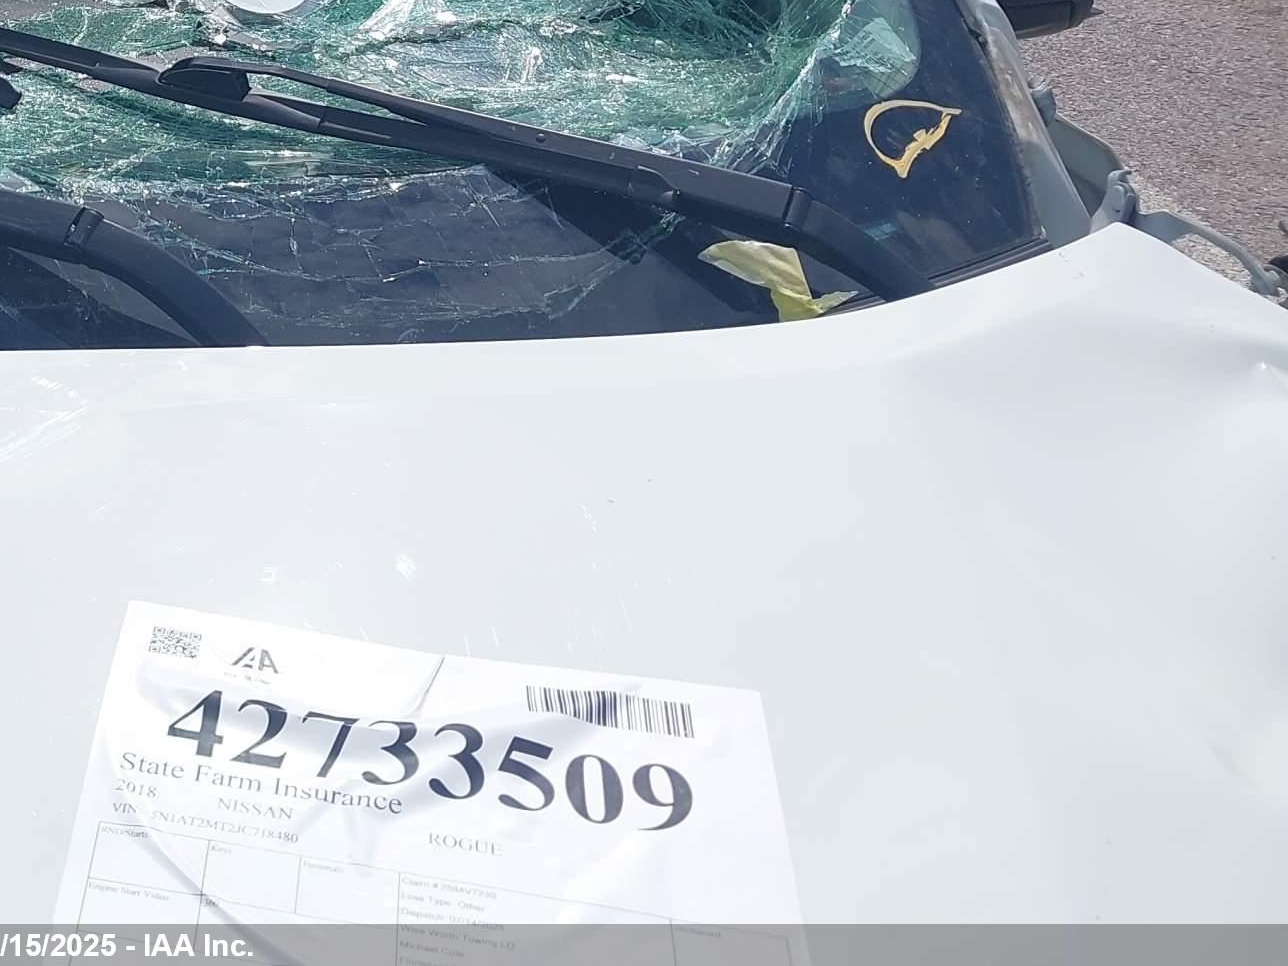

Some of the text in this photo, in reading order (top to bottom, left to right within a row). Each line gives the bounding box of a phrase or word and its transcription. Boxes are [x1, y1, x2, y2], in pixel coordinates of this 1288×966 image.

[167, 689, 693, 831] 42733509
[112, 778, 158, 799] 2018
[120, 752, 403, 814] State Farm Insurance
[217, 796, 294, 819] NISSAN
[428, 832, 503, 856] ROGUE
